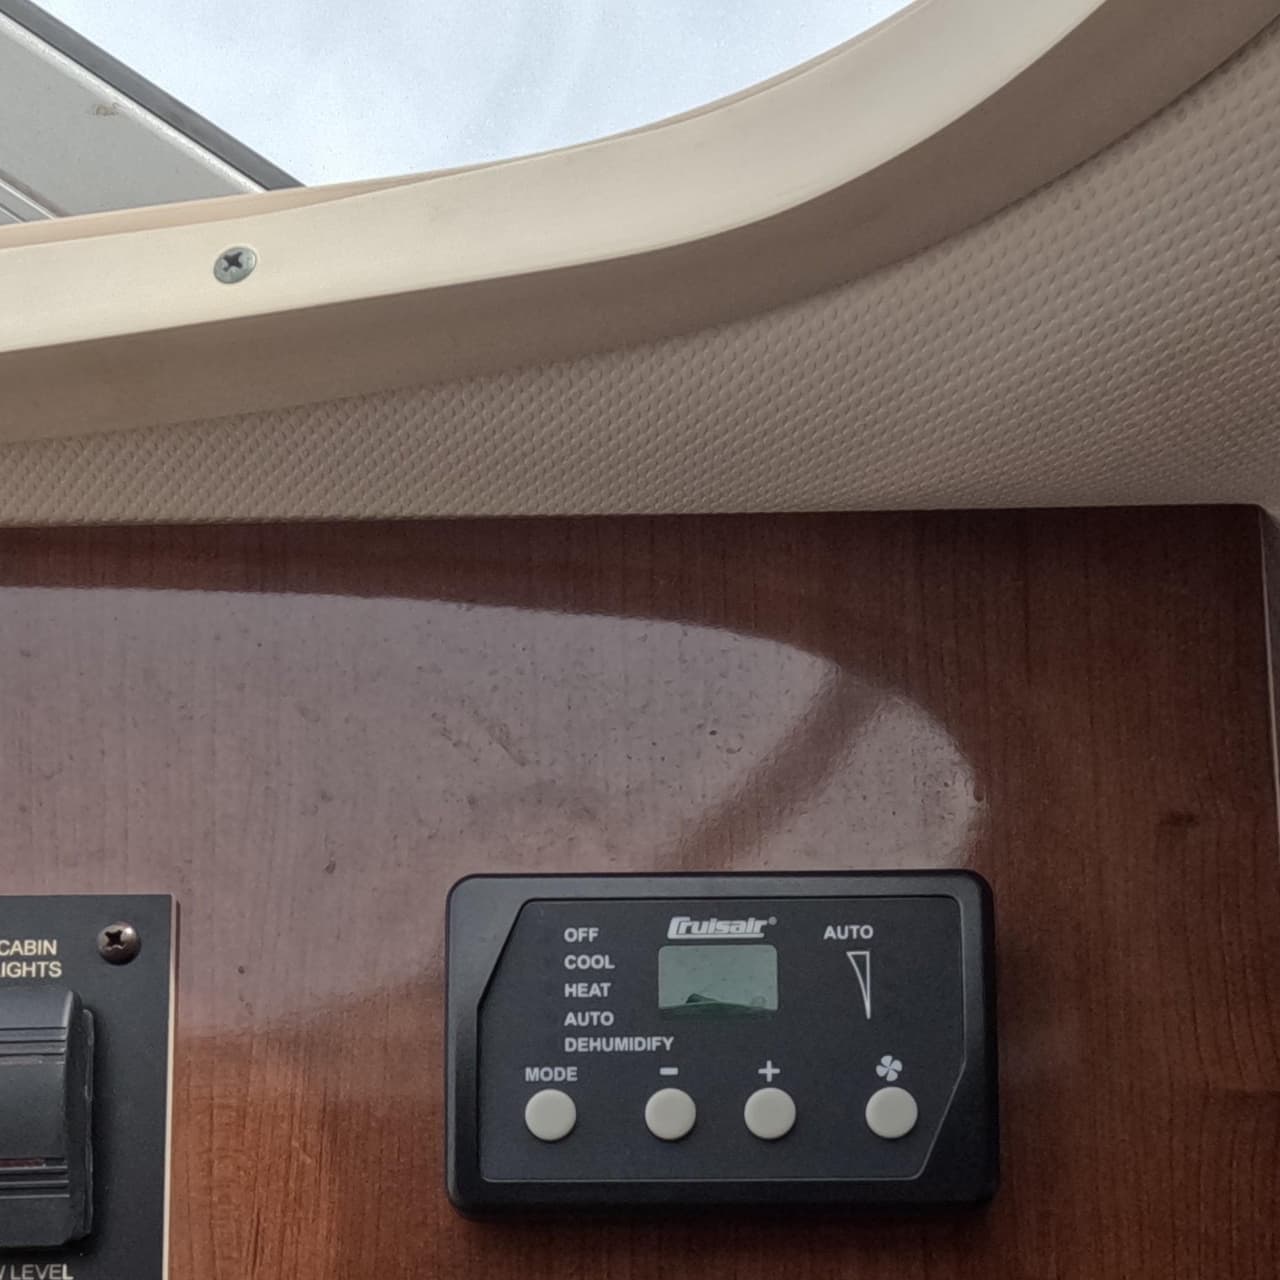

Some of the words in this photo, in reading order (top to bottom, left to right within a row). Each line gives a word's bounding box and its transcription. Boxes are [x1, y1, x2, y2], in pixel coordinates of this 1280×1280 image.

[563, 927, 599, 943] OFF
[823, 924, 874, 940] AUTO
[563, 954, 616, 970] COOL
[564, 982, 612, 998] HEAT
[563, 1011, 615, 1027] AUTO
[564, 1036, 674, 1053] DEHUMIDIFY
[525, 1066, 578, 1082] MODE
[10, 1263, 75, 1280] LEVEL
